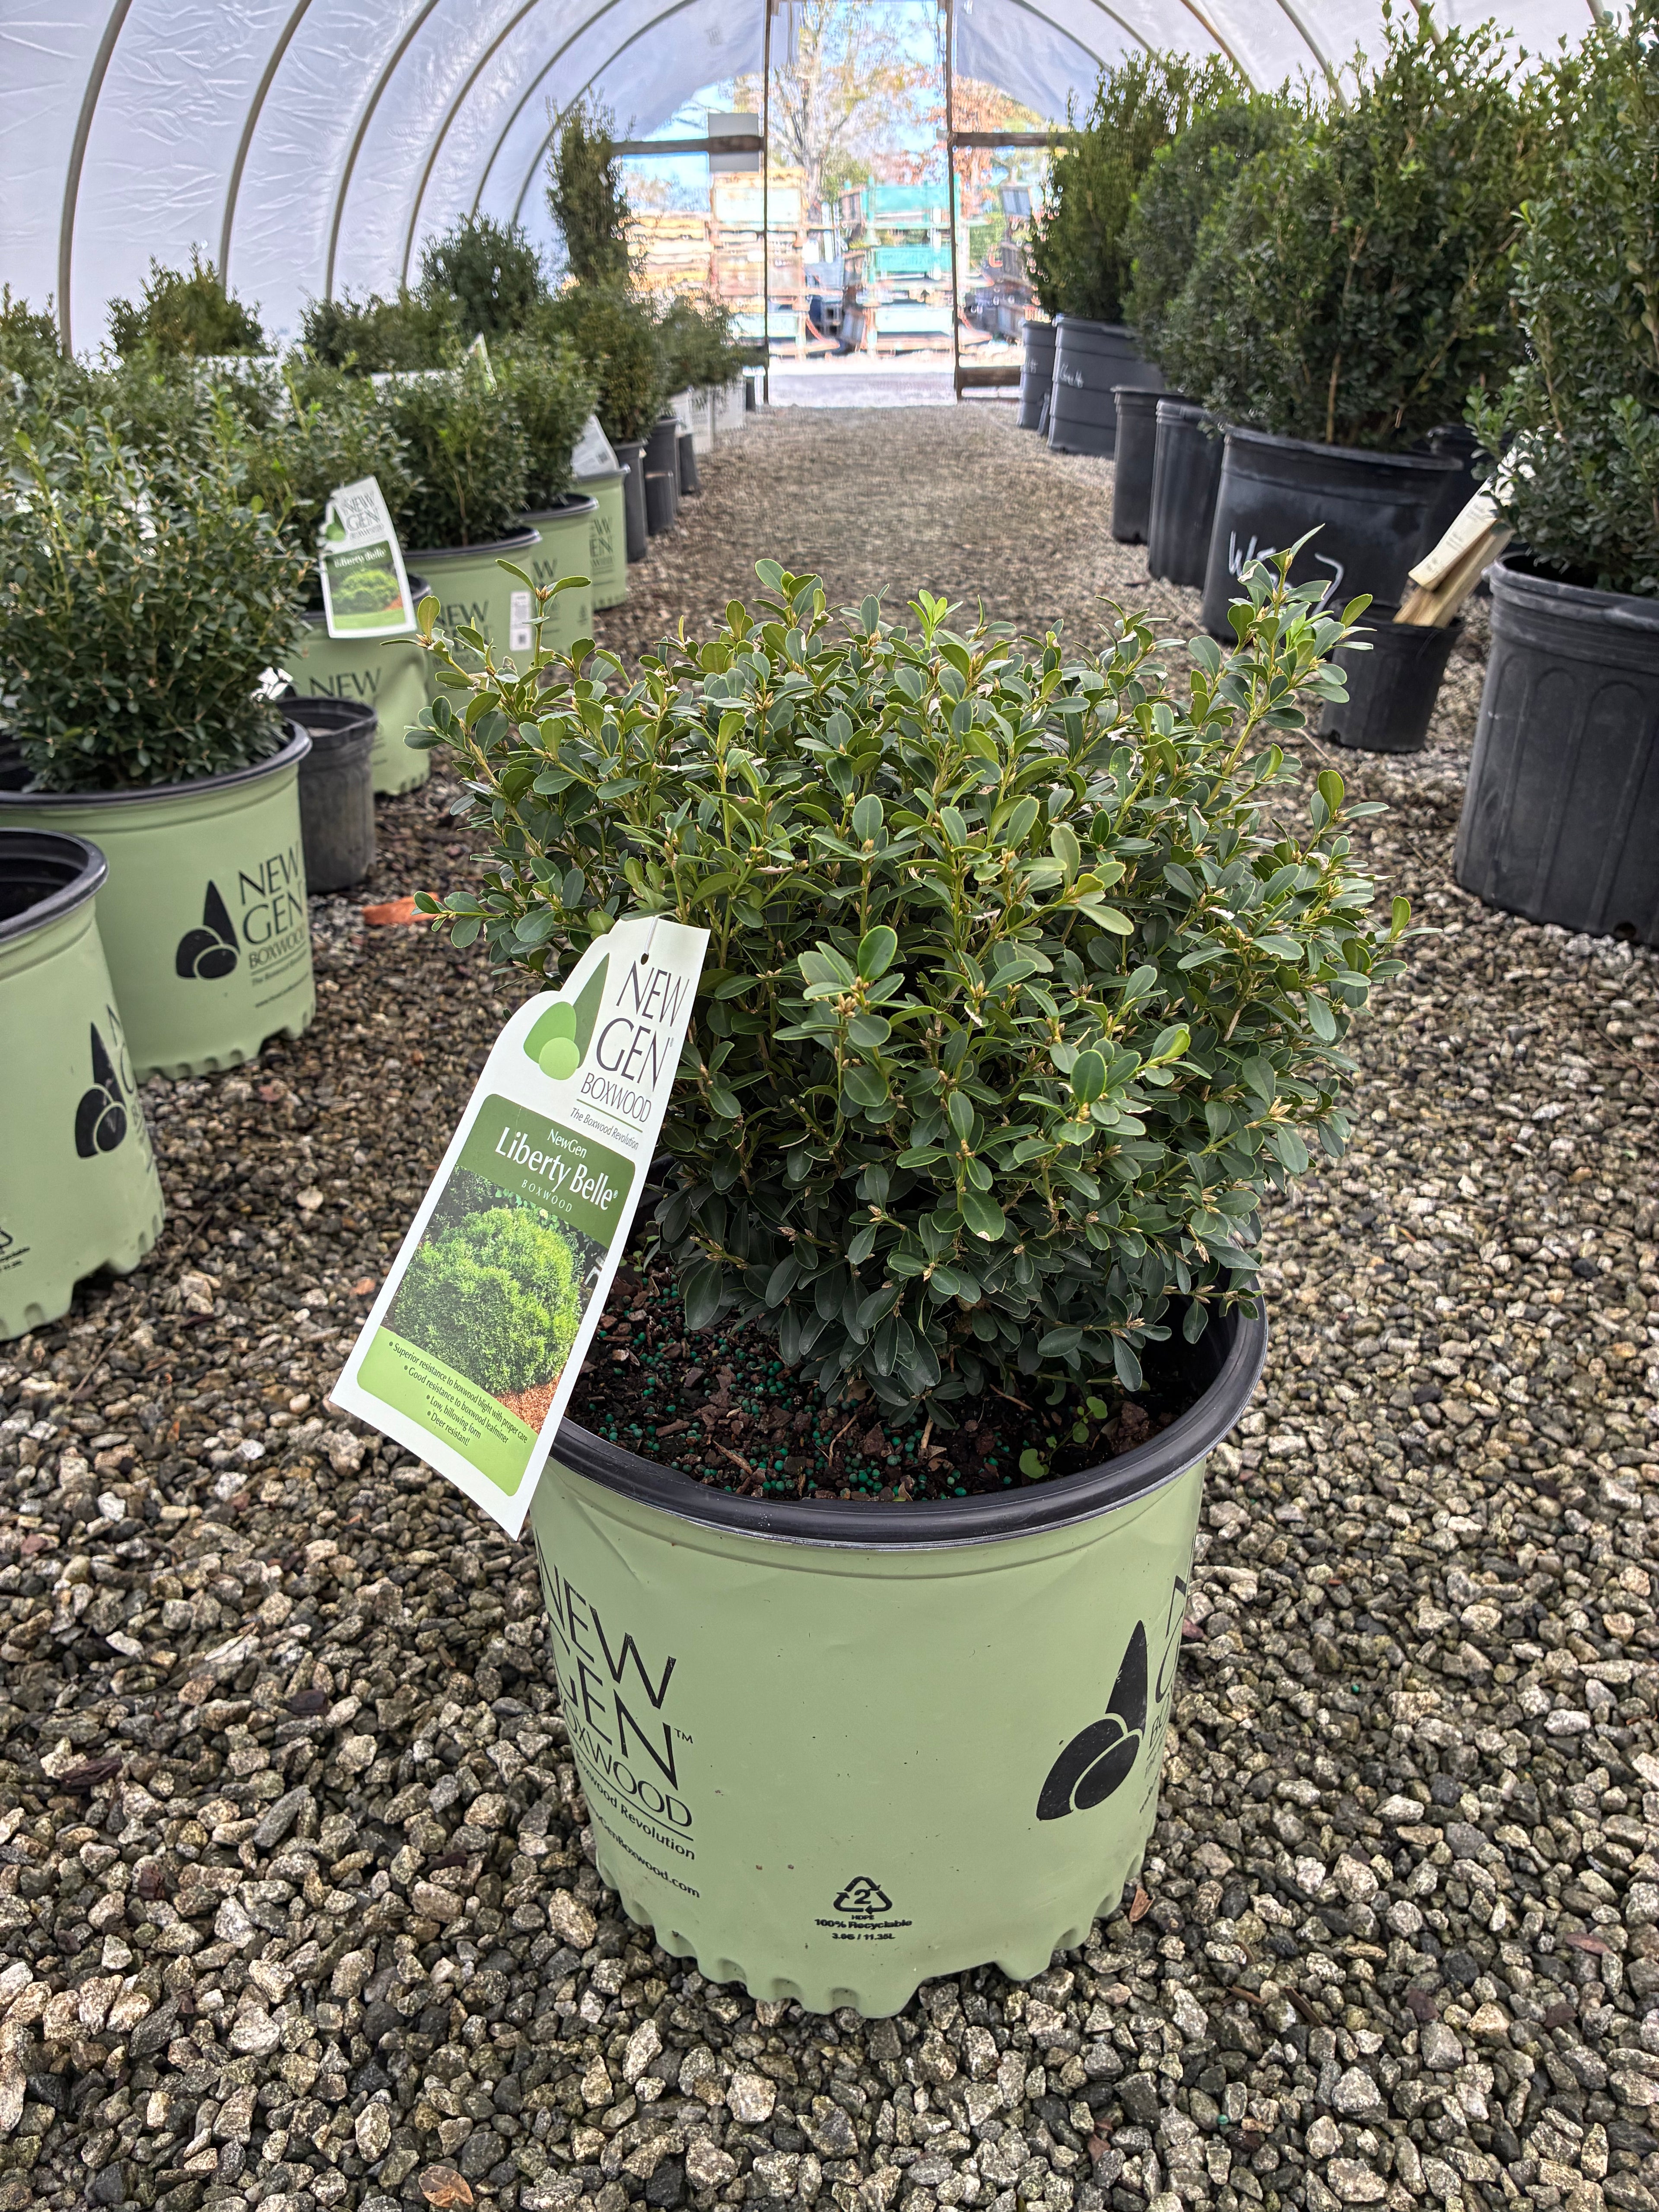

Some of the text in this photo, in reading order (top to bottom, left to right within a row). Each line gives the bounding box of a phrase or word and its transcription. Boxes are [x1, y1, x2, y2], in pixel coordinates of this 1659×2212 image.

[238, 840, 301, 906] NEW
[616, 960, 690, 1027] NEW
[581, 1072, 652, 1122] BOXWOOD
[547, 1128, 587, 1159] NewGen
[570, 1107, 639, 1150] The Boxwood Revolution
[495, 1126, 572, 1193] Liberty
[521, 1179, 572, 1213] BOXWOOD
[393, 1343, 528, 1443] Superior resistance to boxwood blight with proper care
[408, 1367, 509, 1444] Good resistance to boxwood leafminer
[430, 1396, 481, 1440] Low, billowing form
[430, 1412, 470, 1446] Deer resistant!
[535, 1527, 677, 1710] NEW
[563, 1698, 693, 1827] OXWOOD
[620, 1803, 695, 1860] Revolution
[814, 1919, 913, 1930] 100% Recyclable
